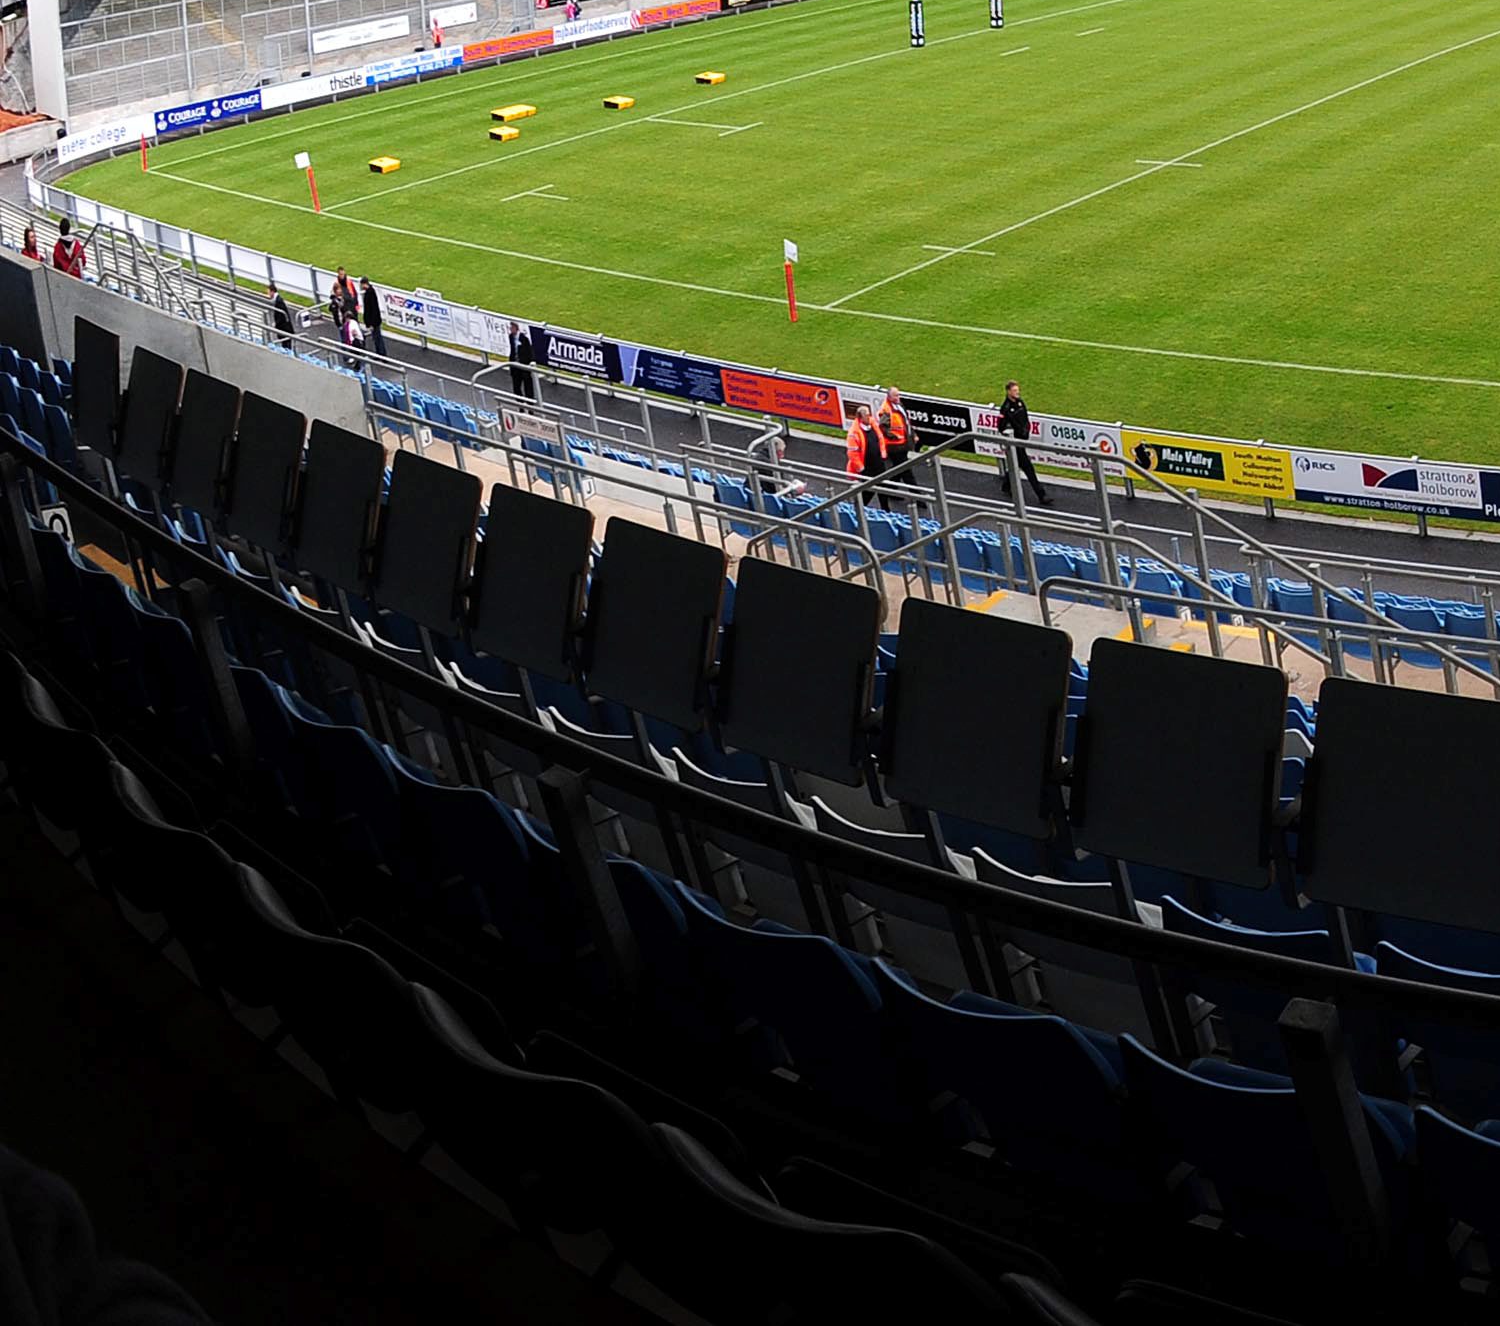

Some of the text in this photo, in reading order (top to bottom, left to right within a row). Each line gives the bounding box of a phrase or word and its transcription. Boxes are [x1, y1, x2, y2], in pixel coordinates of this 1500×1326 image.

[329, 72, 364, 92] thistle
[221, 94, 260, 111] COURAGE
[167, 105, 207, 124] COURAGE
[61, 124, 127, 157] exeter college
[547, 336, 604, 366] Armada
[933, 414, 967, 429] 233178
[1051, 424, 1086, 442] 01884
[1168, 463, 1210, 476] Farmers
[1184, 451, 1213, 470] Valley
[1312, 461, 1336, 472] RICS
[1419, 469, 1476, 485] stratton&
[1420, 483, 1478, 499] holborow
[1323, 494, 1451, 517] www.stratton-holborow.co.uk
